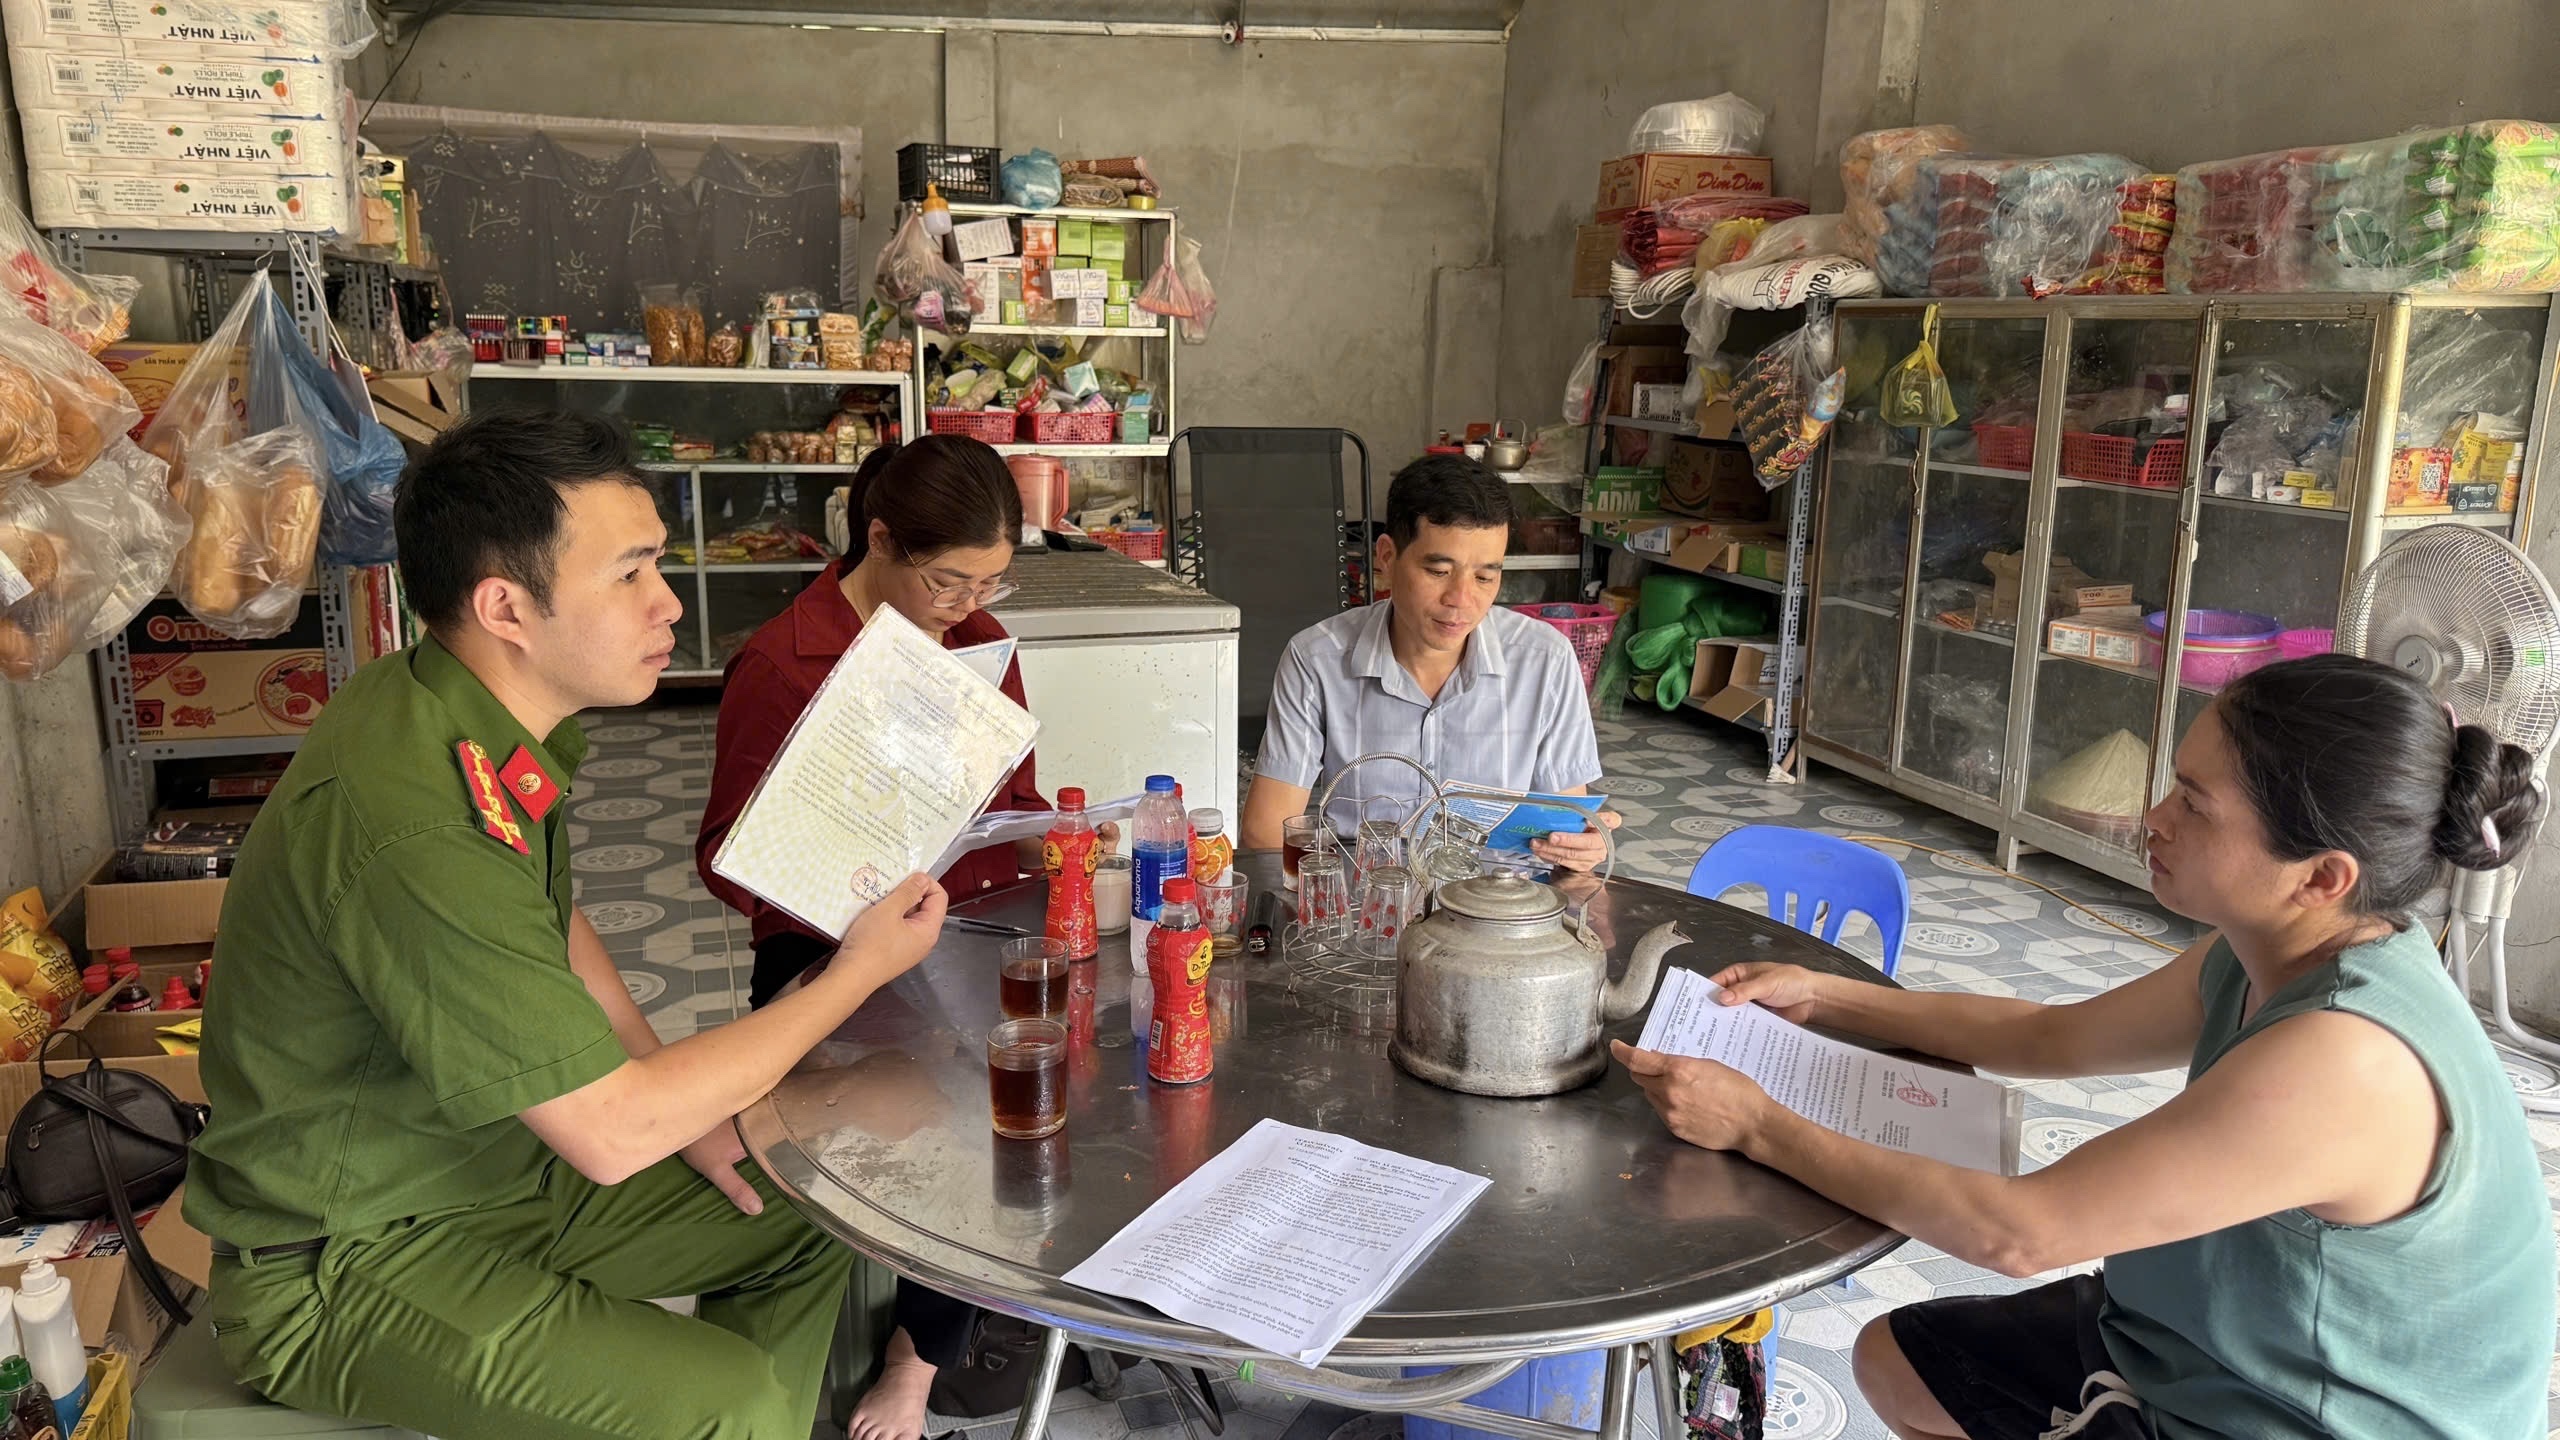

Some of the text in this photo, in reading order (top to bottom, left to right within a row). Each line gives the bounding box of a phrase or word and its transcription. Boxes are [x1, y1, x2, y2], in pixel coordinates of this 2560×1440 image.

[168, 24, 214, 40] NHẬT
[194, 69, 216, 77] ROLLS
[175, 83, 261, 100] VIỆT NHẬT
[203, 129, 226, 138] ROLLS
[184, 144, 270, 160] VIỆT NHẬT
[1697, 172, 1765, 193] DimDim
[210, 187, 233, 195] ROLLS
[190, 200, 276, 217] VIỆT NHẬT
[1597, 490, 1641, 513] ADM
[1132, 857, 1142, 915] Aquaroma
[1189, 1031, 1197, 1043] 9
